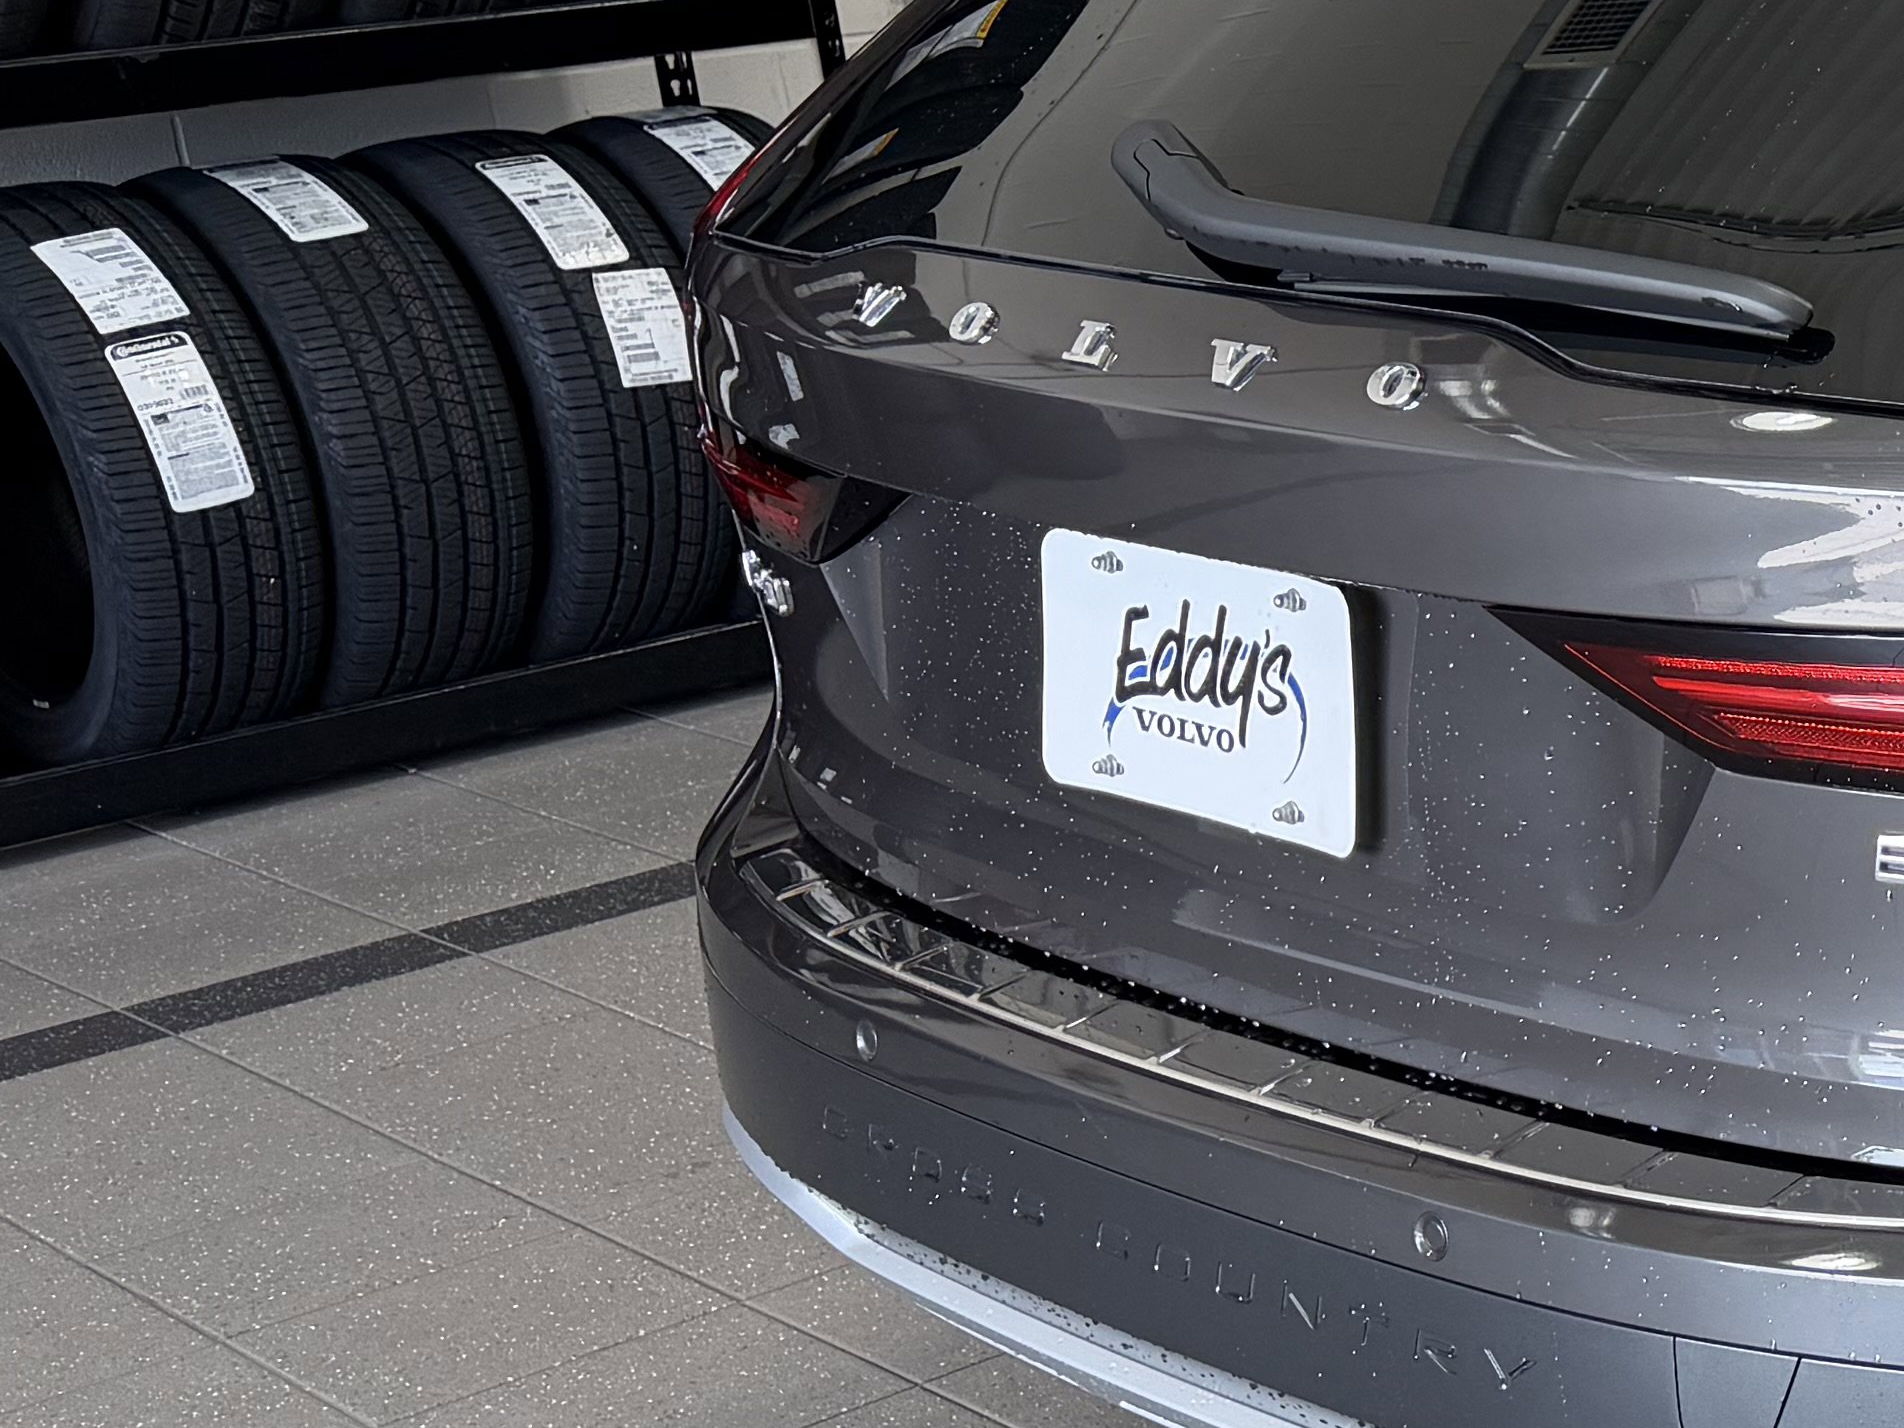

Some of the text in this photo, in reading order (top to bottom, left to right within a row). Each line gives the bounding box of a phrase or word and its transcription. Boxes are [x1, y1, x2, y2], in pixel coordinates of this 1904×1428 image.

[851, 281, 1429, 412] VOLVO
[1114, 599, 1291, 749] Eddy's
[1132, 706, 1237, 754] VOLVO
[1096, 1219, 1538, 1393] COUNTRY
